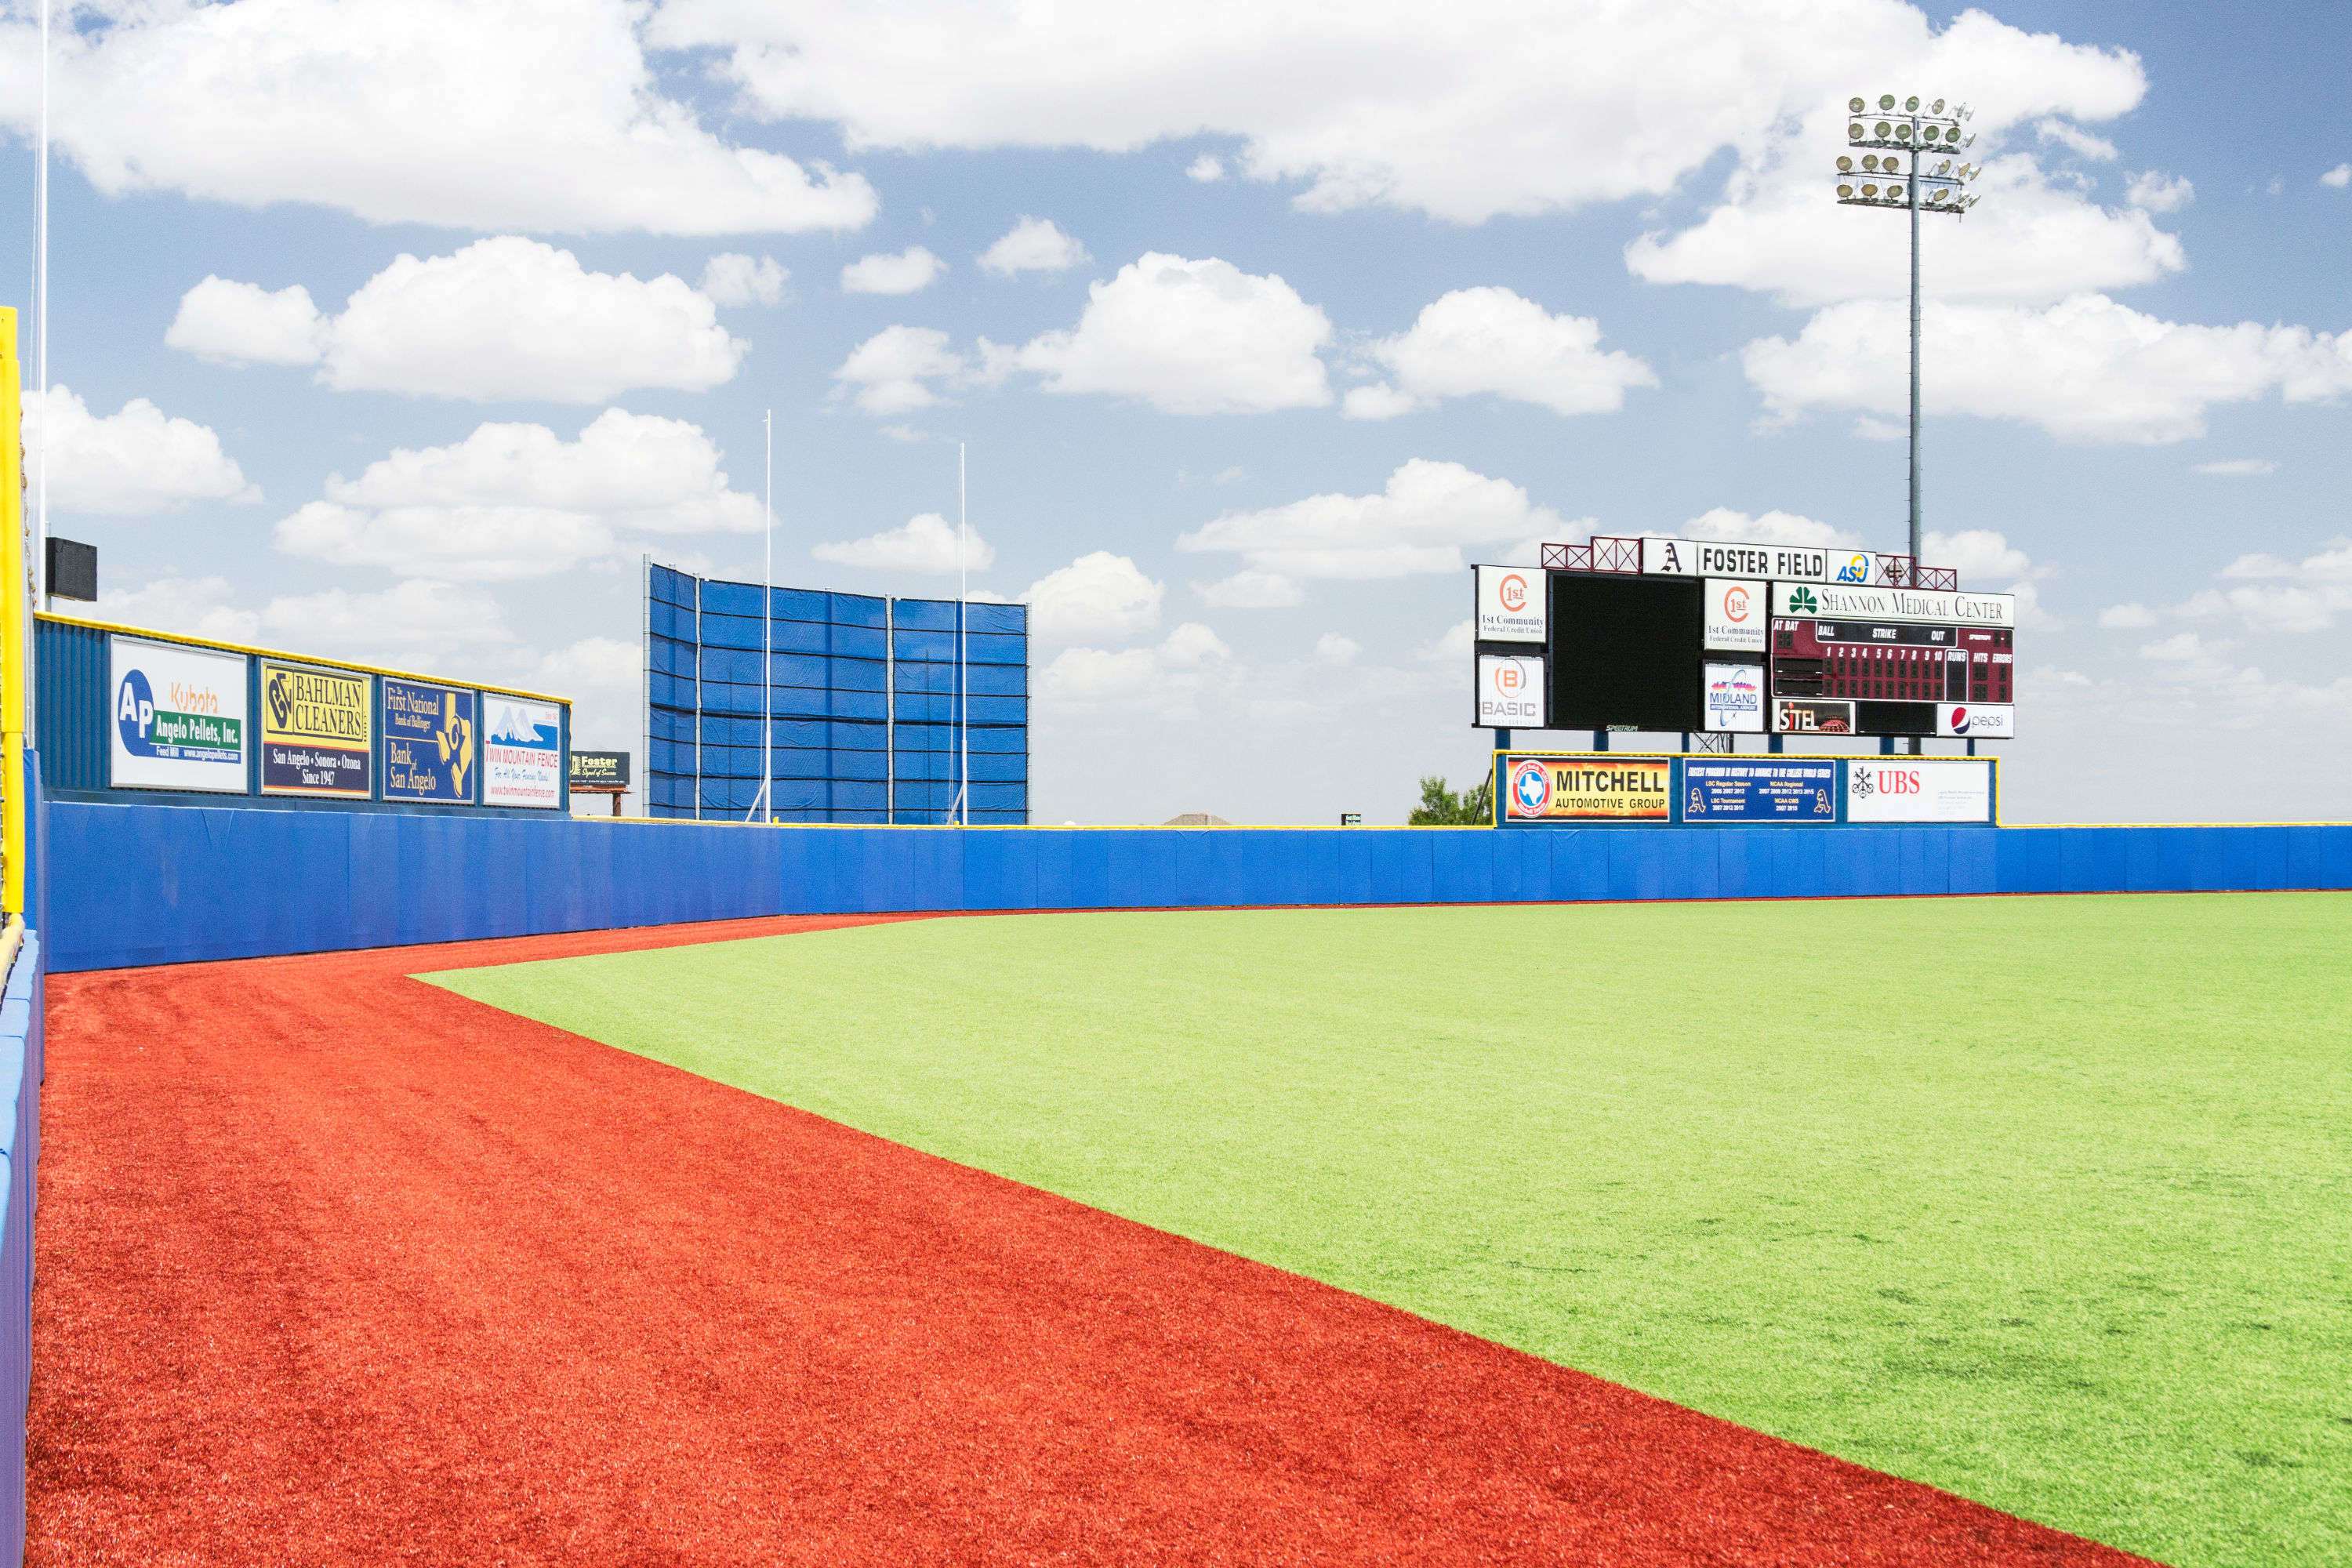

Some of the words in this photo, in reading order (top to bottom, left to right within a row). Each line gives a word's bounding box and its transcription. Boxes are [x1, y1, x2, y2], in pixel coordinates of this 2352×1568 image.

[1703, 548, 1769, 574] FOSTER
[1777, 552, 1823, 576] FIELD
[1836, 561, 1869, 583] ASU
[1506, 586, 1524, 601] 1st
[1730, 598, 1747, 612] 1st
[1483, 615, 1494, 624] 1st
[1497, 615, 1544, 629] Community
[1773, 620, 1784, 631] AT
[1784, 620, 1799, 631] BAT
[1708, 625, 1719, 634] 1st
[1722, 625, 1763, 638] Community
[1818, 625, 1835, 637] BALL
[1872, 628, 1896, 639] STRIKE
[1931, 630, 1945, 641] OUT
[1827, 647, 1831, 656] 1
[1838, 647, 1844, 657] 2
[1851, 648, 1857, 658] 3
[1862, 648, 1867, 658] 4
[1876, 648, 1882, 659] 5
[1887, 649, 1893, 659] 6
[1900, 650, 1906, 659] 7
[1911, 650, 1917, 660] 8
[1925, 651, 1929, 660] 9
[1934, 651, 1943, 661] 10
[1947, 652, 1966, 662] RUNS
[1973, 652, 1988, 662] HITS
[1992, 653, 2013, 663] ERRORS
[170, 682, 219, 713] Kubota
[296, 675, 361, 709] BAHLMAN
[1709, 692, 1757, 704] MIDLAND
[387, 688, 407, 712] First
[407, 691, 439, 715] National
[1482, 702, 1537, 717] BASIC
[296, 704, 361, 736] CLEANERS
[395, 713, 406, 726] Bank
[1971, 714, 2003, 731] pepsi
[156, 715, 187, 744] Angelo
[190, 718, 221, 745] Pellets,
[223, 721, 238, 744] Inc.
[156, 746, 169, 757] Feed
[273, 748, 286, 764] San
[287, 750, 310, 770] Angelo
[314, 752, 337, 768] Sonora
[341, 754, 361, 770] Ozona
[390, 742, 412, 764] Bank
[503, 748, 535, 766] MOUNTAIN
[538, 753, 558, 768] FENCE
[581, 756, 618, 768] Foster
[302, 769, 320, 785] Since
[320, 771, 335, 786] 1947
[390, 767, 405, 789] San
[407, 767, 436, 796] Angelo
[1556, 770, 1664, 793] MITCHELL
[1878, 771, 1920, 794] UBS
[1555, 798, 1624, 808] AUTOMOTIVE
[1629, 798, 1665, 809] GROUP
